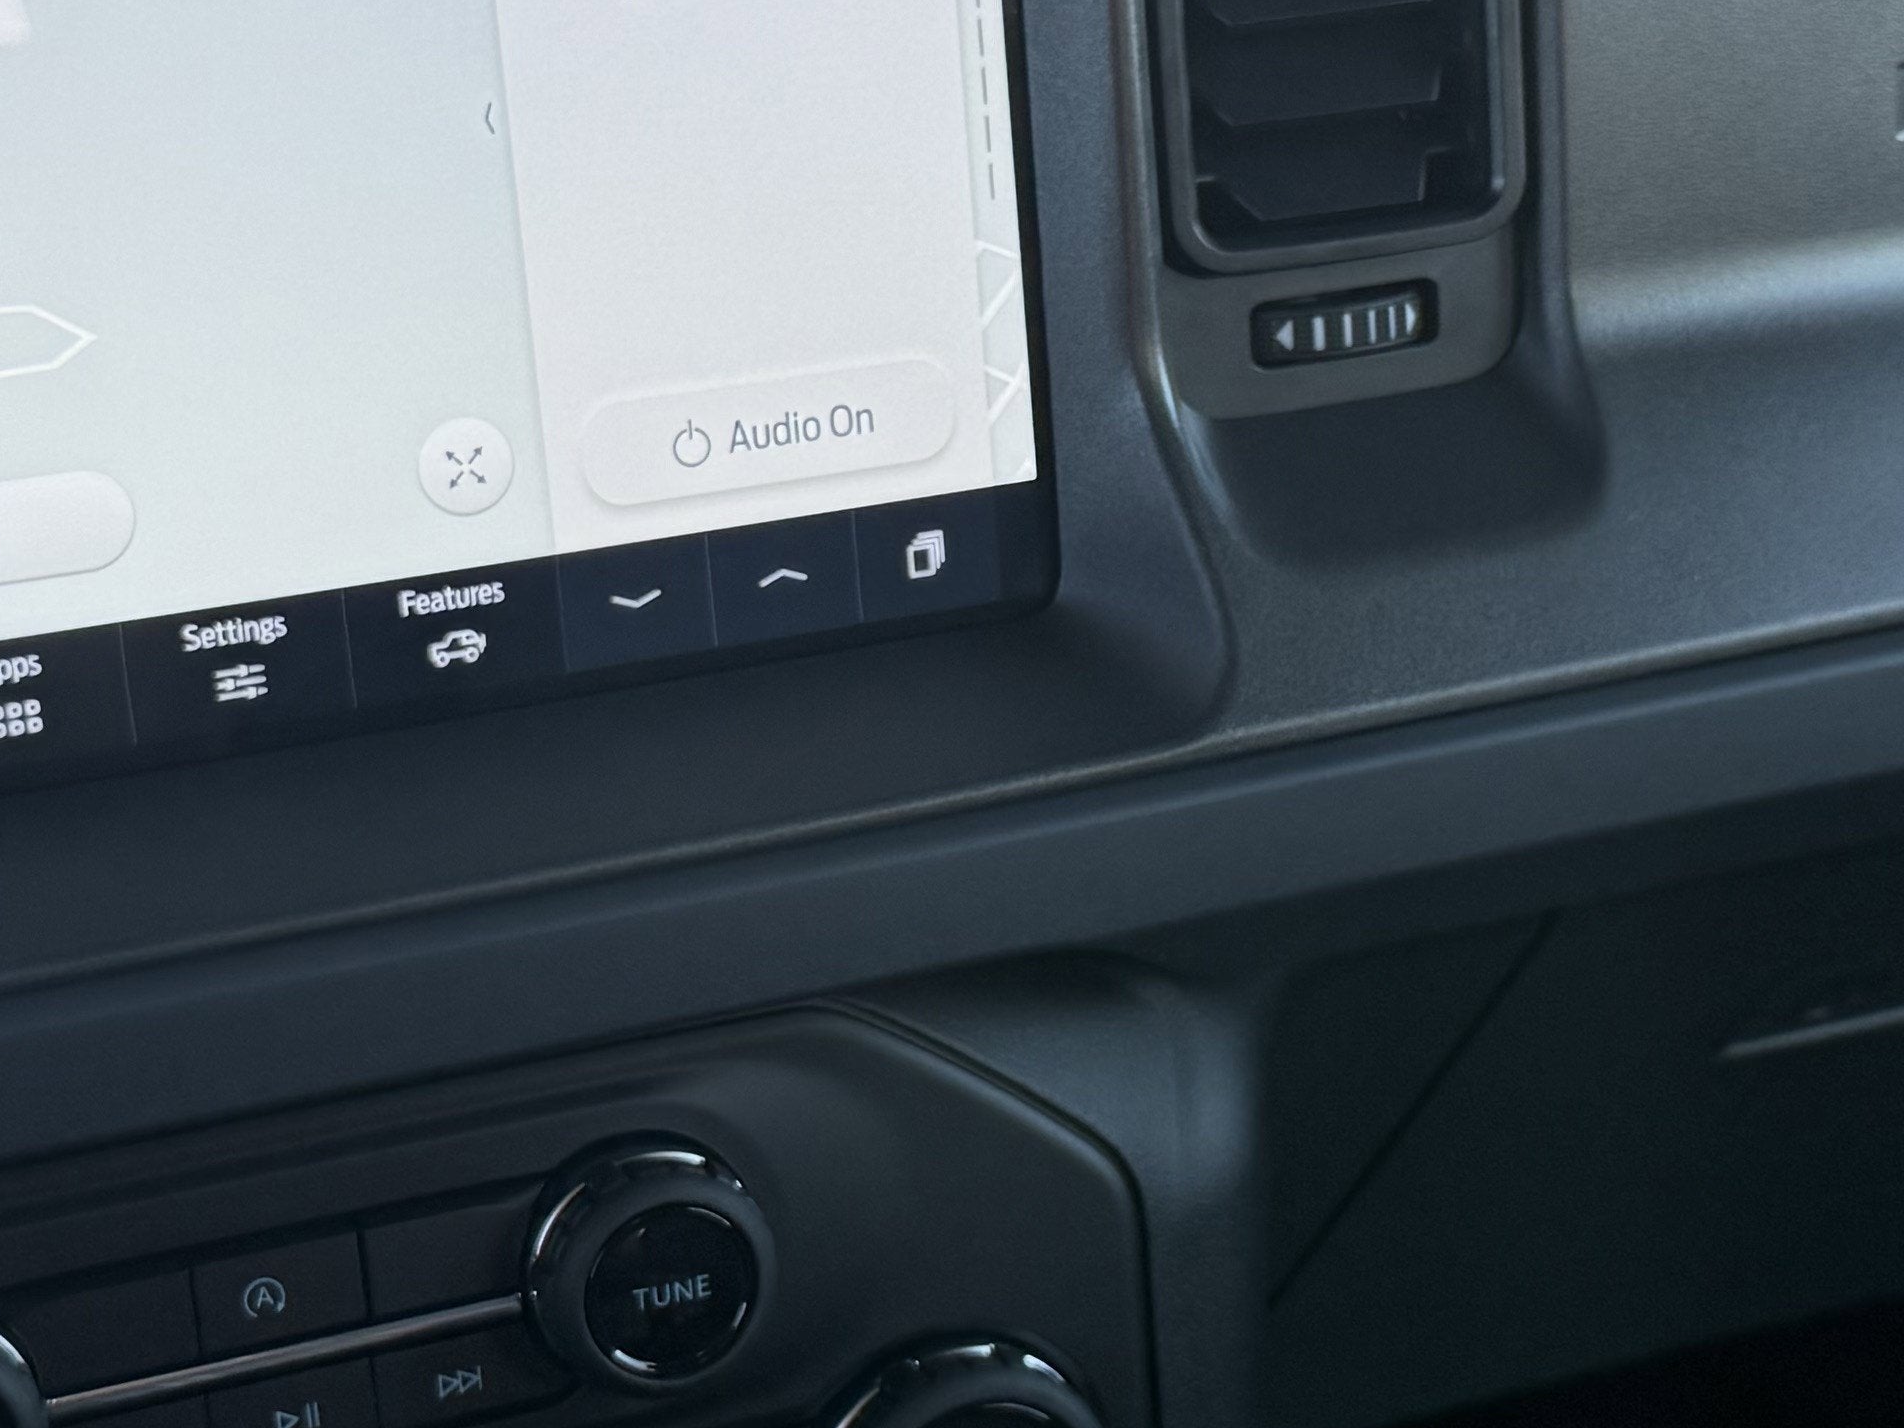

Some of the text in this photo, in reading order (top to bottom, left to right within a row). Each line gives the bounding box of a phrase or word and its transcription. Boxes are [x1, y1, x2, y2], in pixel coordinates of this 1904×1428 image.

[730, 405, 874, 453] Audio On
[398, 580, 505, 617] Features
[180, 613, 287, 651] Settings
[633, 1274, 711, 1310] TUNE
